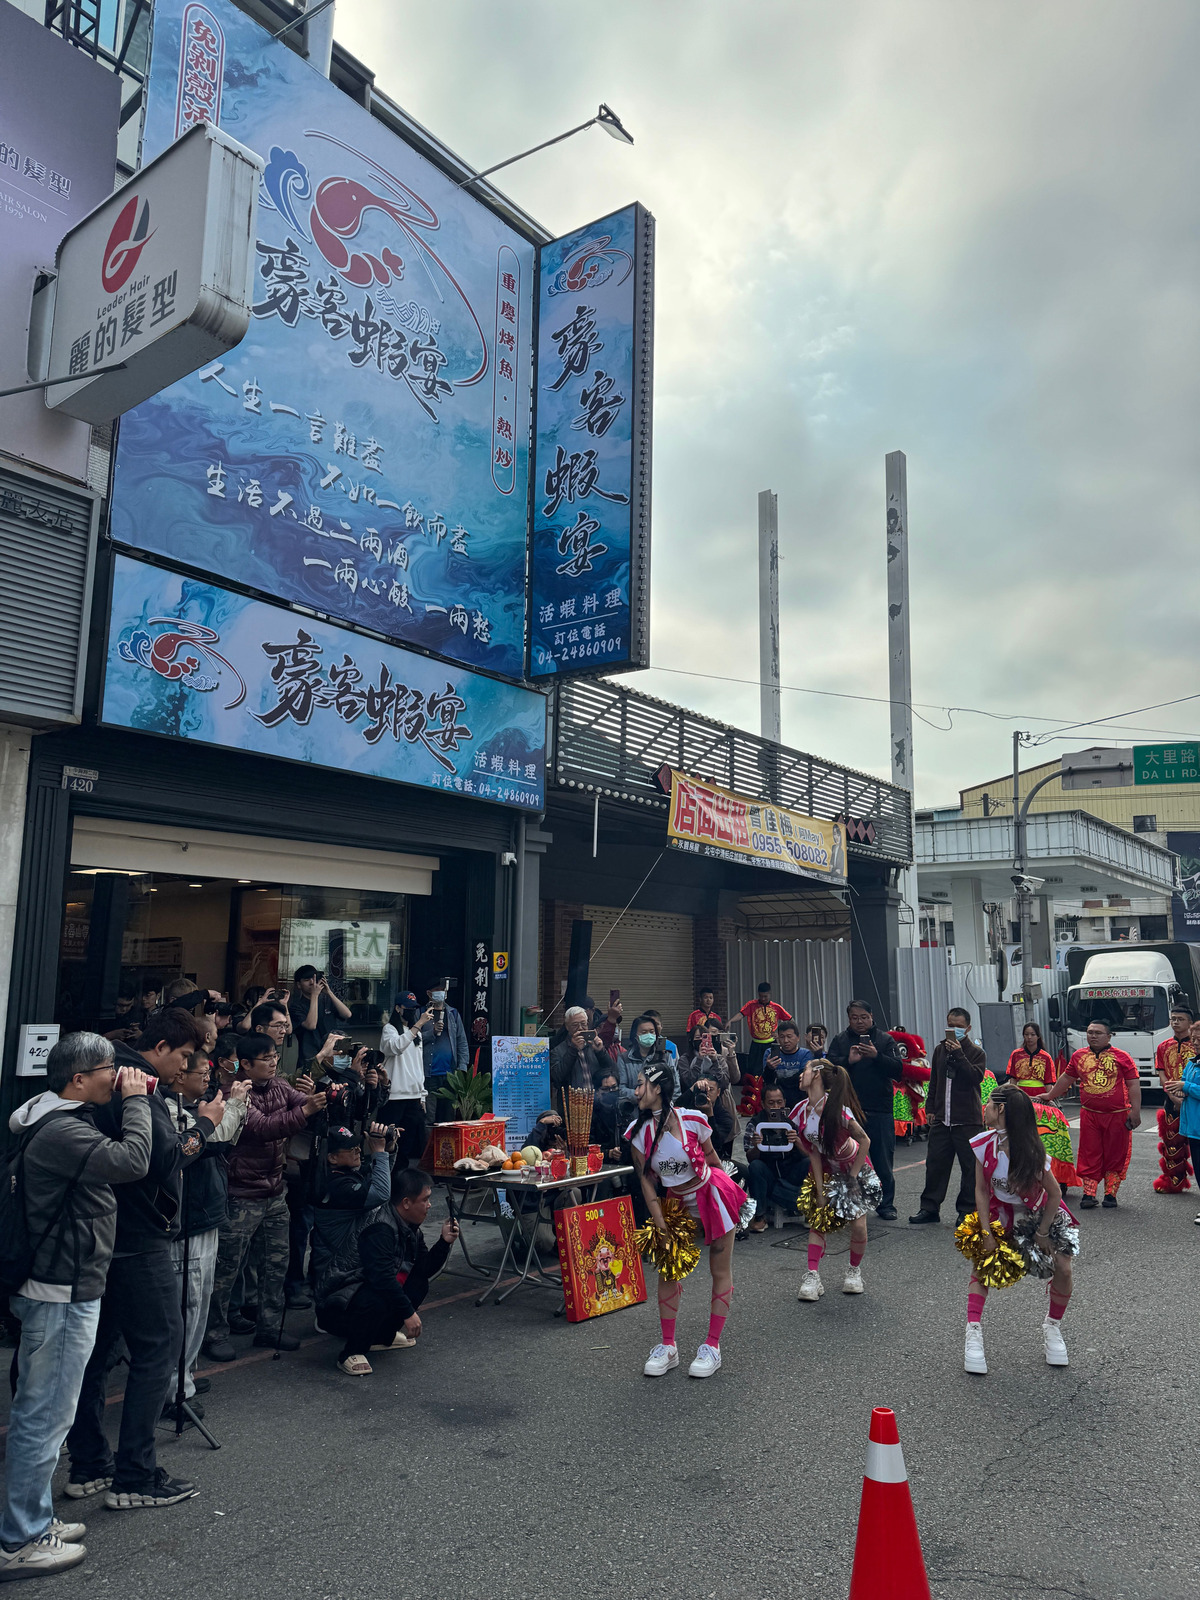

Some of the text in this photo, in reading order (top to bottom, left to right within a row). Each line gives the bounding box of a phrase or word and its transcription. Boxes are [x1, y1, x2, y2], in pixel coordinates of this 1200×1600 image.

[182, 19, 219, 133] 免剝殼活
[4, 204, 24, 219] 1979
[15, 200, 48, 223] SALON
[97, 275, 152, 321] Leader Hair
[67, 268, 179, 376] 麗的髮型
[251, 236, 456, 423] 豪客蝦宴
[198, 361, 386, 475] 人生一言難盡
[541, 305, 631, 579] 豪客蝦宴
[204, 459, 411, 573] 生活不過二兩酒
[319, 462, 471, 558] 不如一飲而盡
[302, 555, 414, 615] 一兩心酸
[539, 587, 623, 625] 活蝦料理
[538, 637, 622, 666] 04-24860909
[554, 622, 607, 646] 訂位電話
[245, 628, 473, 775] 豪客蝦宴
[474, 750, 537, 780] 活蝦料理
[1142, 770, 1159, 780] DA
[1165, 769, 1175, 779] LI
[1145, 749, 1196, 766] 大里路
[69, 777, 94, 793] 420
[479, 783, 540, 807] 04-24860909
[673, 779, 751, 849] 店面出租
[749, 805, 793, 837] 曾佳梅
[752, 831, 828, 867] 0955-508082
[28, 1047, 49, 1058] 420
[585, 1209, 599, 1222] 500
